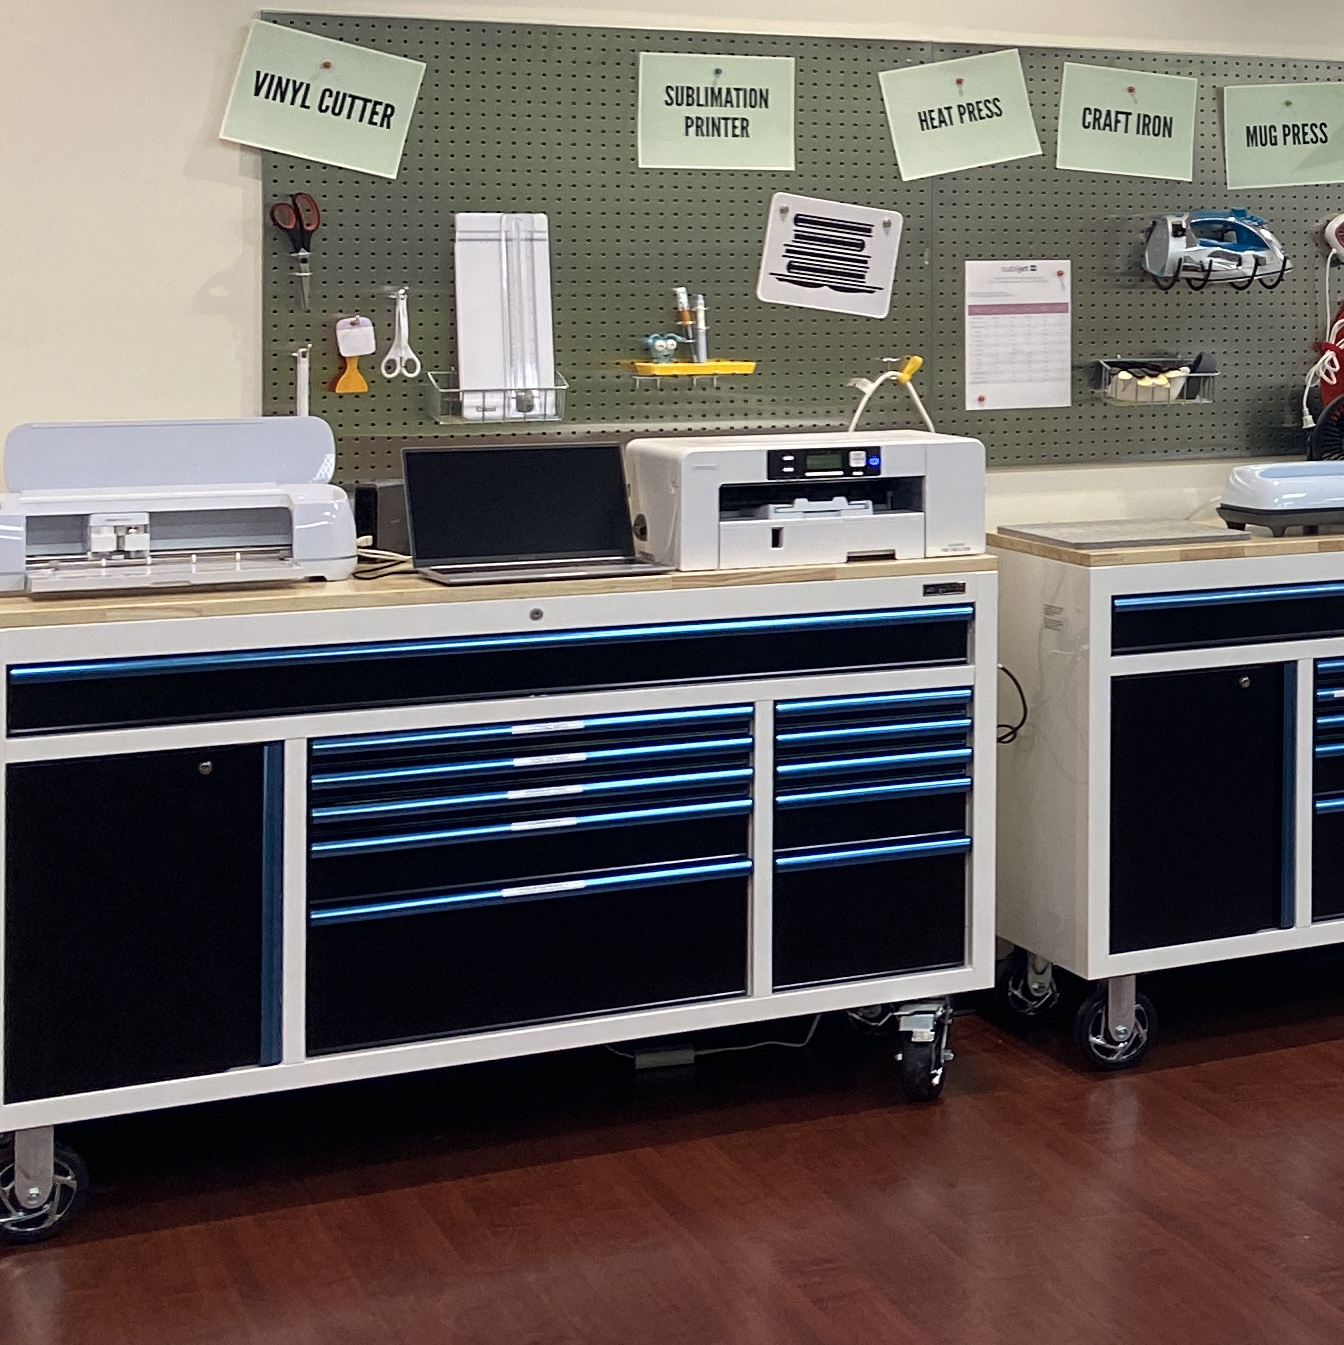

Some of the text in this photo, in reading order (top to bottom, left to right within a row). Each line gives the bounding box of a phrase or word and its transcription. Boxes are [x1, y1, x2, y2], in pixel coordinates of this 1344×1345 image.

[253, 70, 396, 130] VINYL CUTTER
[664, 85, 769, 109] SUBLIMATION
[684, 115, 750, 138] PRINTER
[917, 97, 1003, 132] HEAT PRESS
[1081, 106, 1173, 138] CRAFT IRON
[1245, 122, 1329, 148] MUG PRESS
